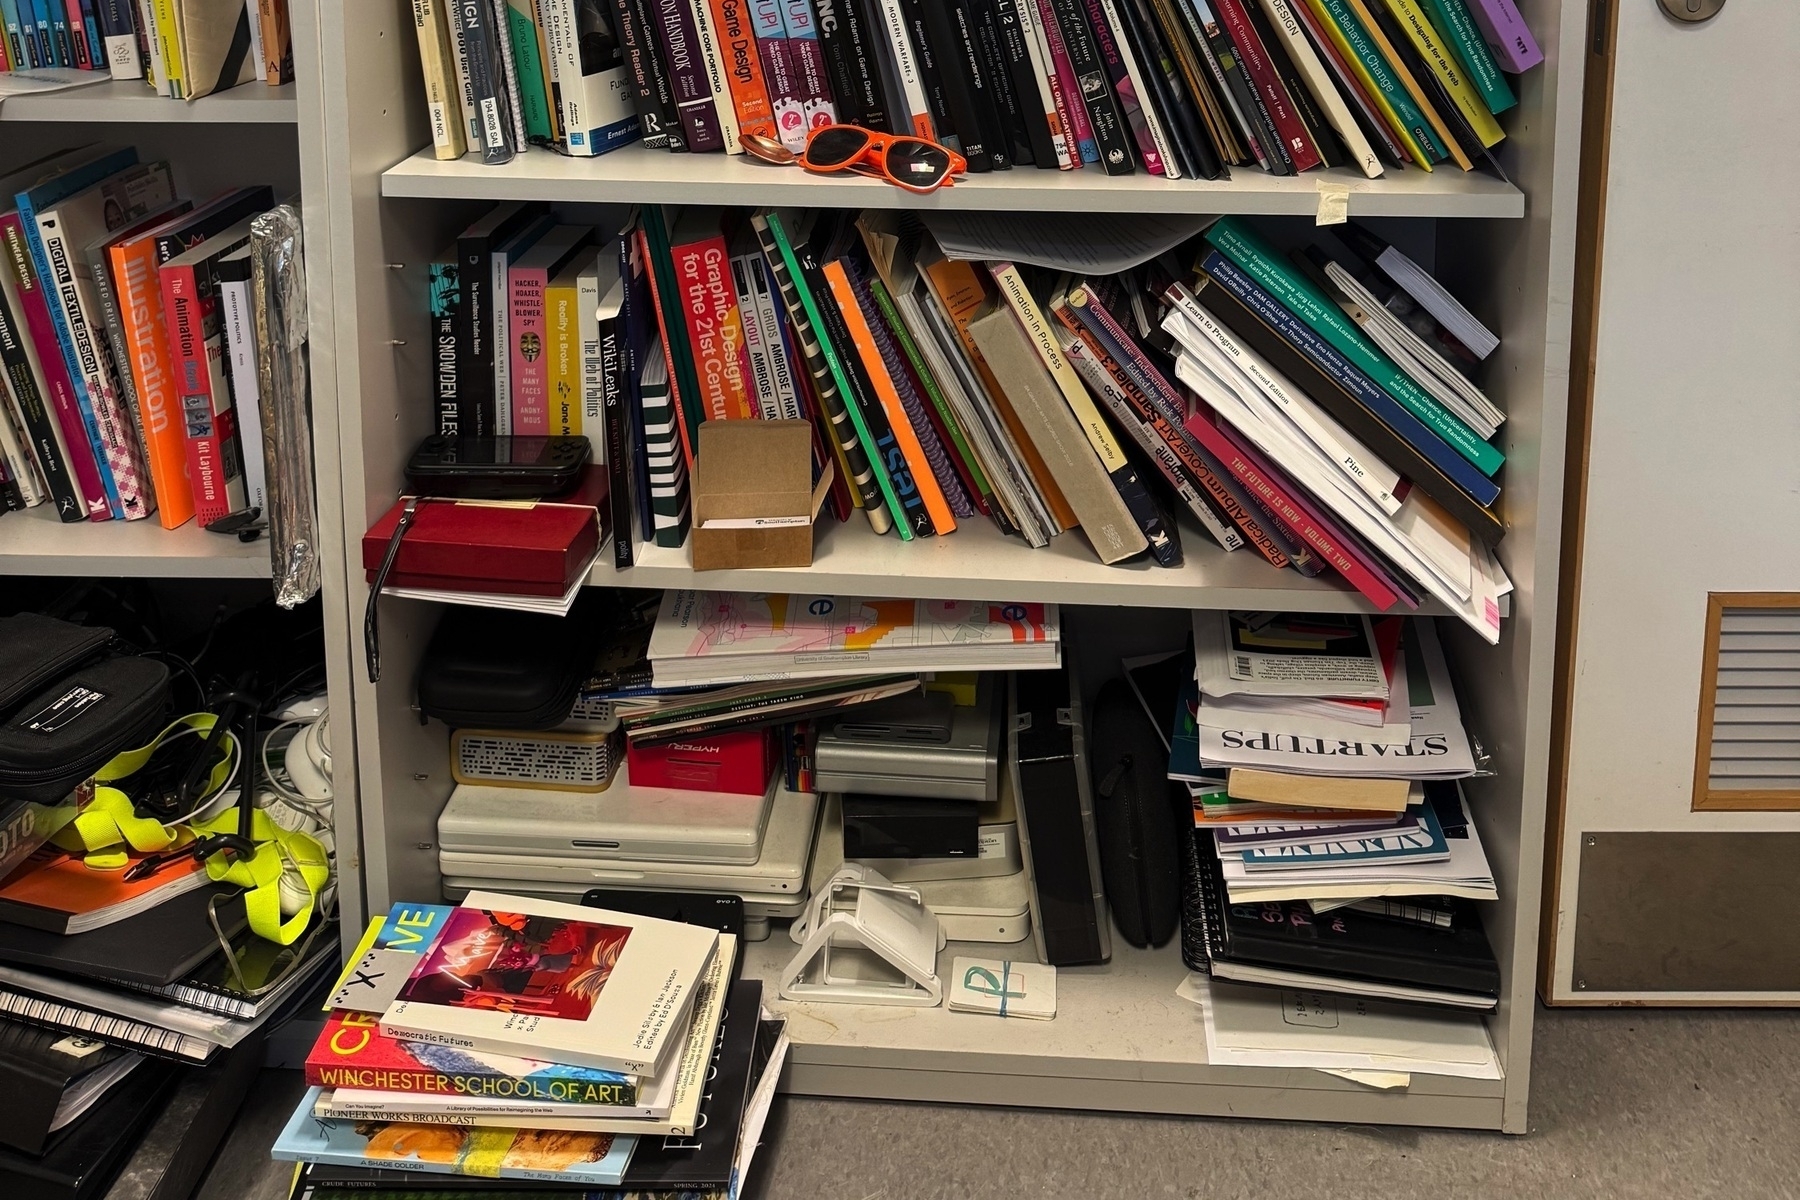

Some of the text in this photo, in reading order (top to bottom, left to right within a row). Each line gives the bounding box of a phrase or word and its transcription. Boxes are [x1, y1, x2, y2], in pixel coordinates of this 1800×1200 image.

[553, 15, 563, 55] DESIGN
[1330, 0, 1341, 16] for
[1338, 13, 1370, 53] Behavior
[1366, 49, 1394, 93] Change
[1515, 36, 1528, 55] TATE
[568, 54, 574, 67] OF
[733, 39, 754, 84] Design
[6, 226, 32, 290] KNITWEAR DESIGN
[49, 238, 97, 374] DIGITAL TEXTILE DESIGN
[513, 299, 543, 308] WHISTLE-
[514, 279, 542, 288] HACKER,
[515, 289, 542, 298] HOAXER,
[581, 286, 597, 294] Davis
[682, 252, 714, 357] for the 21st
[172, 278, 194, 357] The Animation
[515, 308, 543, 318] BLOWER,
[522, 318, 536, 326] SPY
[704, 248, 743, 391] Graphic Design
[1003, 274, 1064, 371] Animation in Process
[1184, 301, 1241, 357] Learn to Program
[121, 256, 170, 435] Illustration
[602, 333, 617, 407] WikiLeaks
[743, 310, 772, 398] LAYOUT AMBROSE
[763, 308, 790, 389] GRIDS AMBROSE
[438, 318, 458, 436] THE SNOWDEN FILES
[1090, 421, 1115, 461] Andrew Selby
[198, 440, 215, 501] Kit Laybourne
[1344, 456, 1365, 478] Pine
[1231, 457, 1352, 572] THE FUTURE IS NOW VOLUME TWO
[1223, 729, 1449, 757] STARTUPS
[320, 1067, 623, 1102] WINCHESTER SCHOOL OF ART
[324, 1108, 477, 1125] PIONEER WORKS BROADCAST
